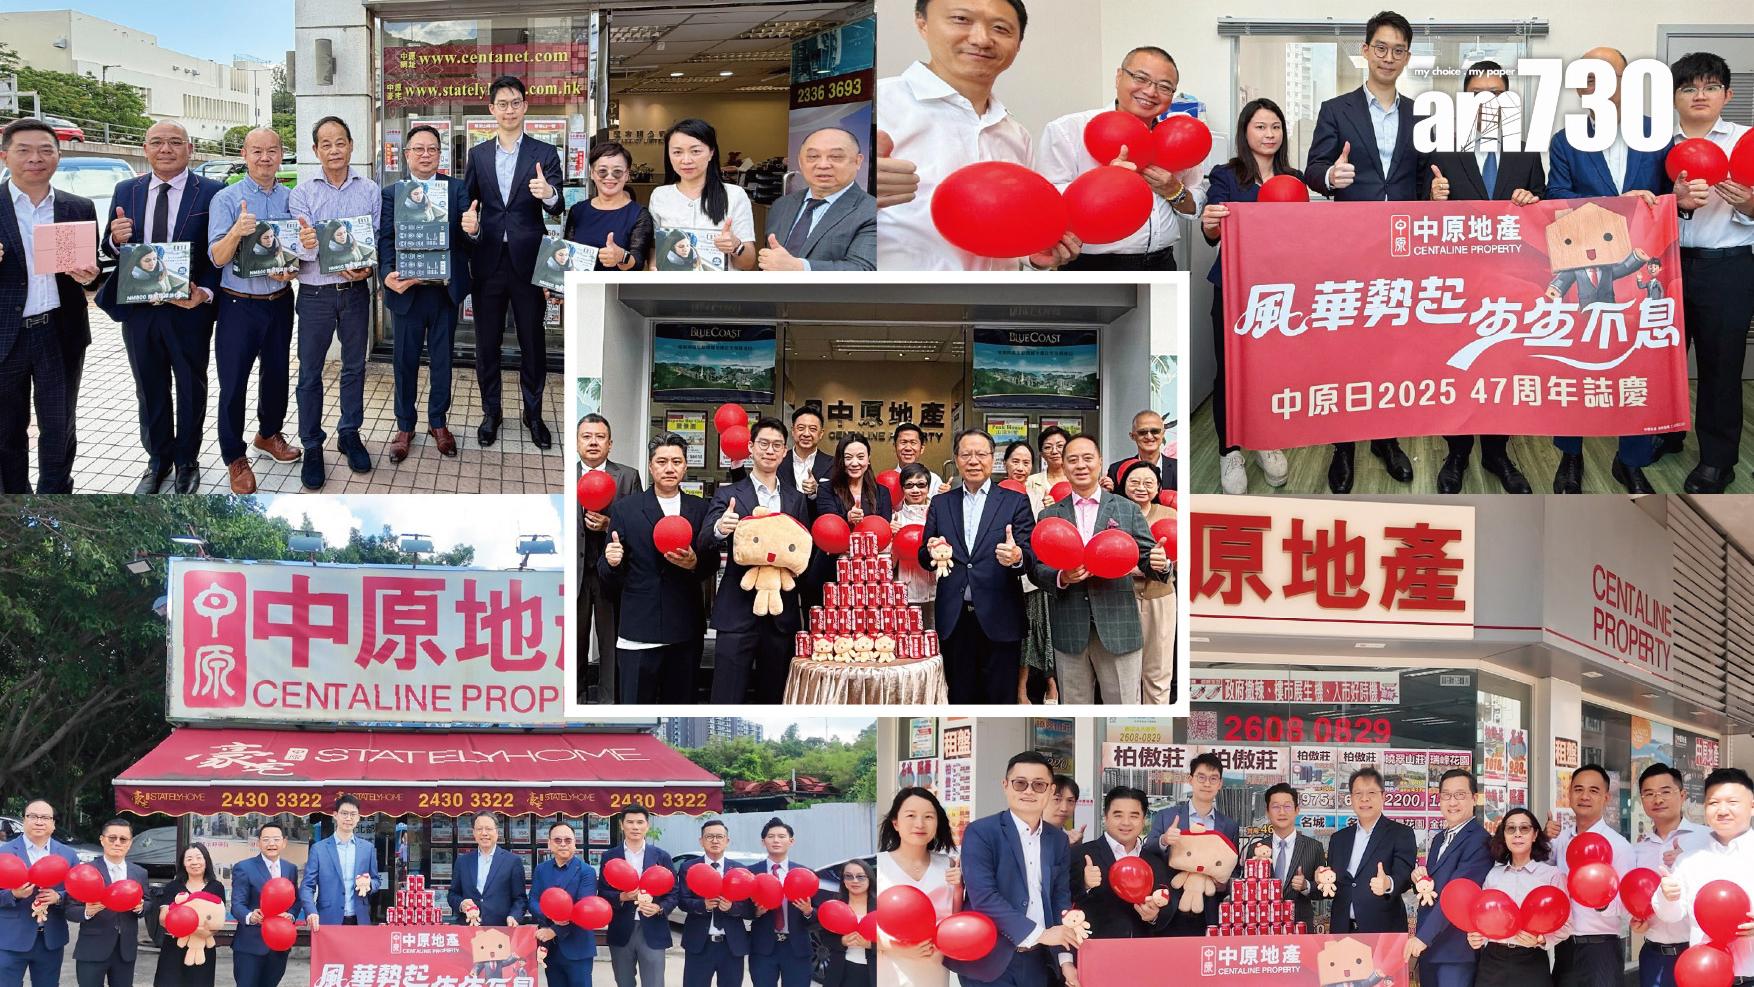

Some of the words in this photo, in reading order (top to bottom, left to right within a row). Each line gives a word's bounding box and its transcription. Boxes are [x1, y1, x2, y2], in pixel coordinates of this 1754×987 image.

[418, 51, 569, 65] www.centanet.com
[405, 81, 582, 99] www.stately.com.hk
[797, 85, 825, 103] 2336
[828, 78, 862, 98] 3693
[1413, 215, 1521, 243] 中原地產
[1413, 245, 1468, 256] CENTALINE
[1471, 244, 1522, 254] PROPERTY
[1271, 378, 1456, 420] 中原日2025
[1470, 374, 1648, 408] 47周年誌慶
[828, 400, 945, 428] 中原地產
[1592, 564, 1672, 638] CENTALINE
[253, 574, 564, 673] 中原地
[1594, 606, 1671, 672] PROPERTY
[253, 679, 452, 713] CENTALINE
[461, 684, 564, 714] PROP
[1119, 733, 1162, 742] 2608-0829
[1223, 715, 1304, 742] 2608
[1313, 717, 1392, 744] 0829
[314, 747, 651, 764] STATELYHOME
[1113, 745, 1186, 769] 柏傲莊
[150, 792, 206, 801] STATELYHOME
[222, 792, 269, 807] 2430
[276, 793, 322, 808] 3322
[418, 793, 464, 808] 2430
[470, 792, 514, 807] 3322
[544, 792, 595, 802] STATELYHOME
[610, 793, 656, 808] 2430
[662, 792, 708, 807] 3322
[1301, 816, 1325, 828] 名城
[402, 933, 460, 947] 中原地產
[1218, 945, 1301, 966] 中原地產
[1218, 967, 1260, 975] CENTALINE
[1261, 966, 1301, 974] PROPERTY
